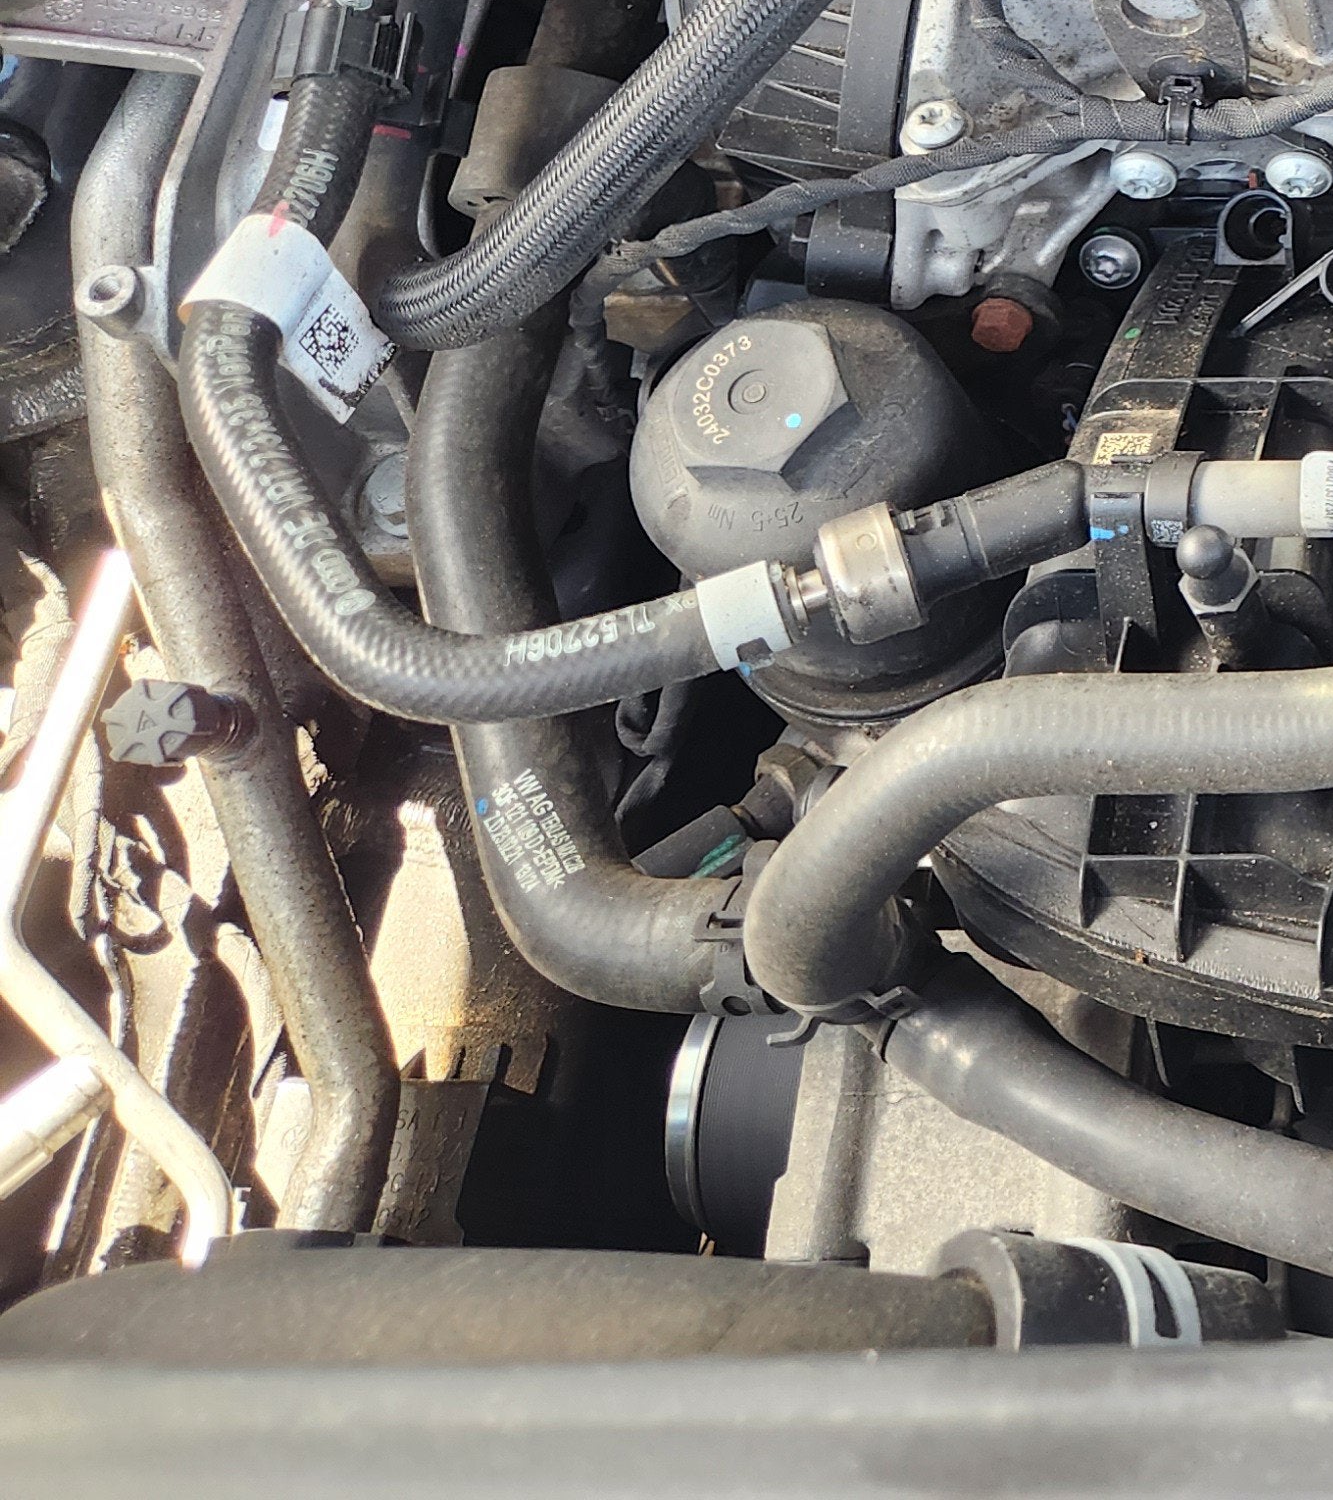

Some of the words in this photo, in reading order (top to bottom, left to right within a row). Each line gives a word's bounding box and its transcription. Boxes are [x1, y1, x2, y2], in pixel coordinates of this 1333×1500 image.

[692, 335, 753, 445] 24032C0373
[259, 468, 315, 515] VRT
[282, 511, 338, 549] DE
[513, 768, 543, 796] VW
[525, 792, 554, 816] AG
[505, 802, 529, 824] 121
[532, 845, 566, 890] >EPDM<
[540, 811, 571, 847] TEKLAS
[555, 840, 578, 859] MX
[514, 863, 540, 894] 13/24
